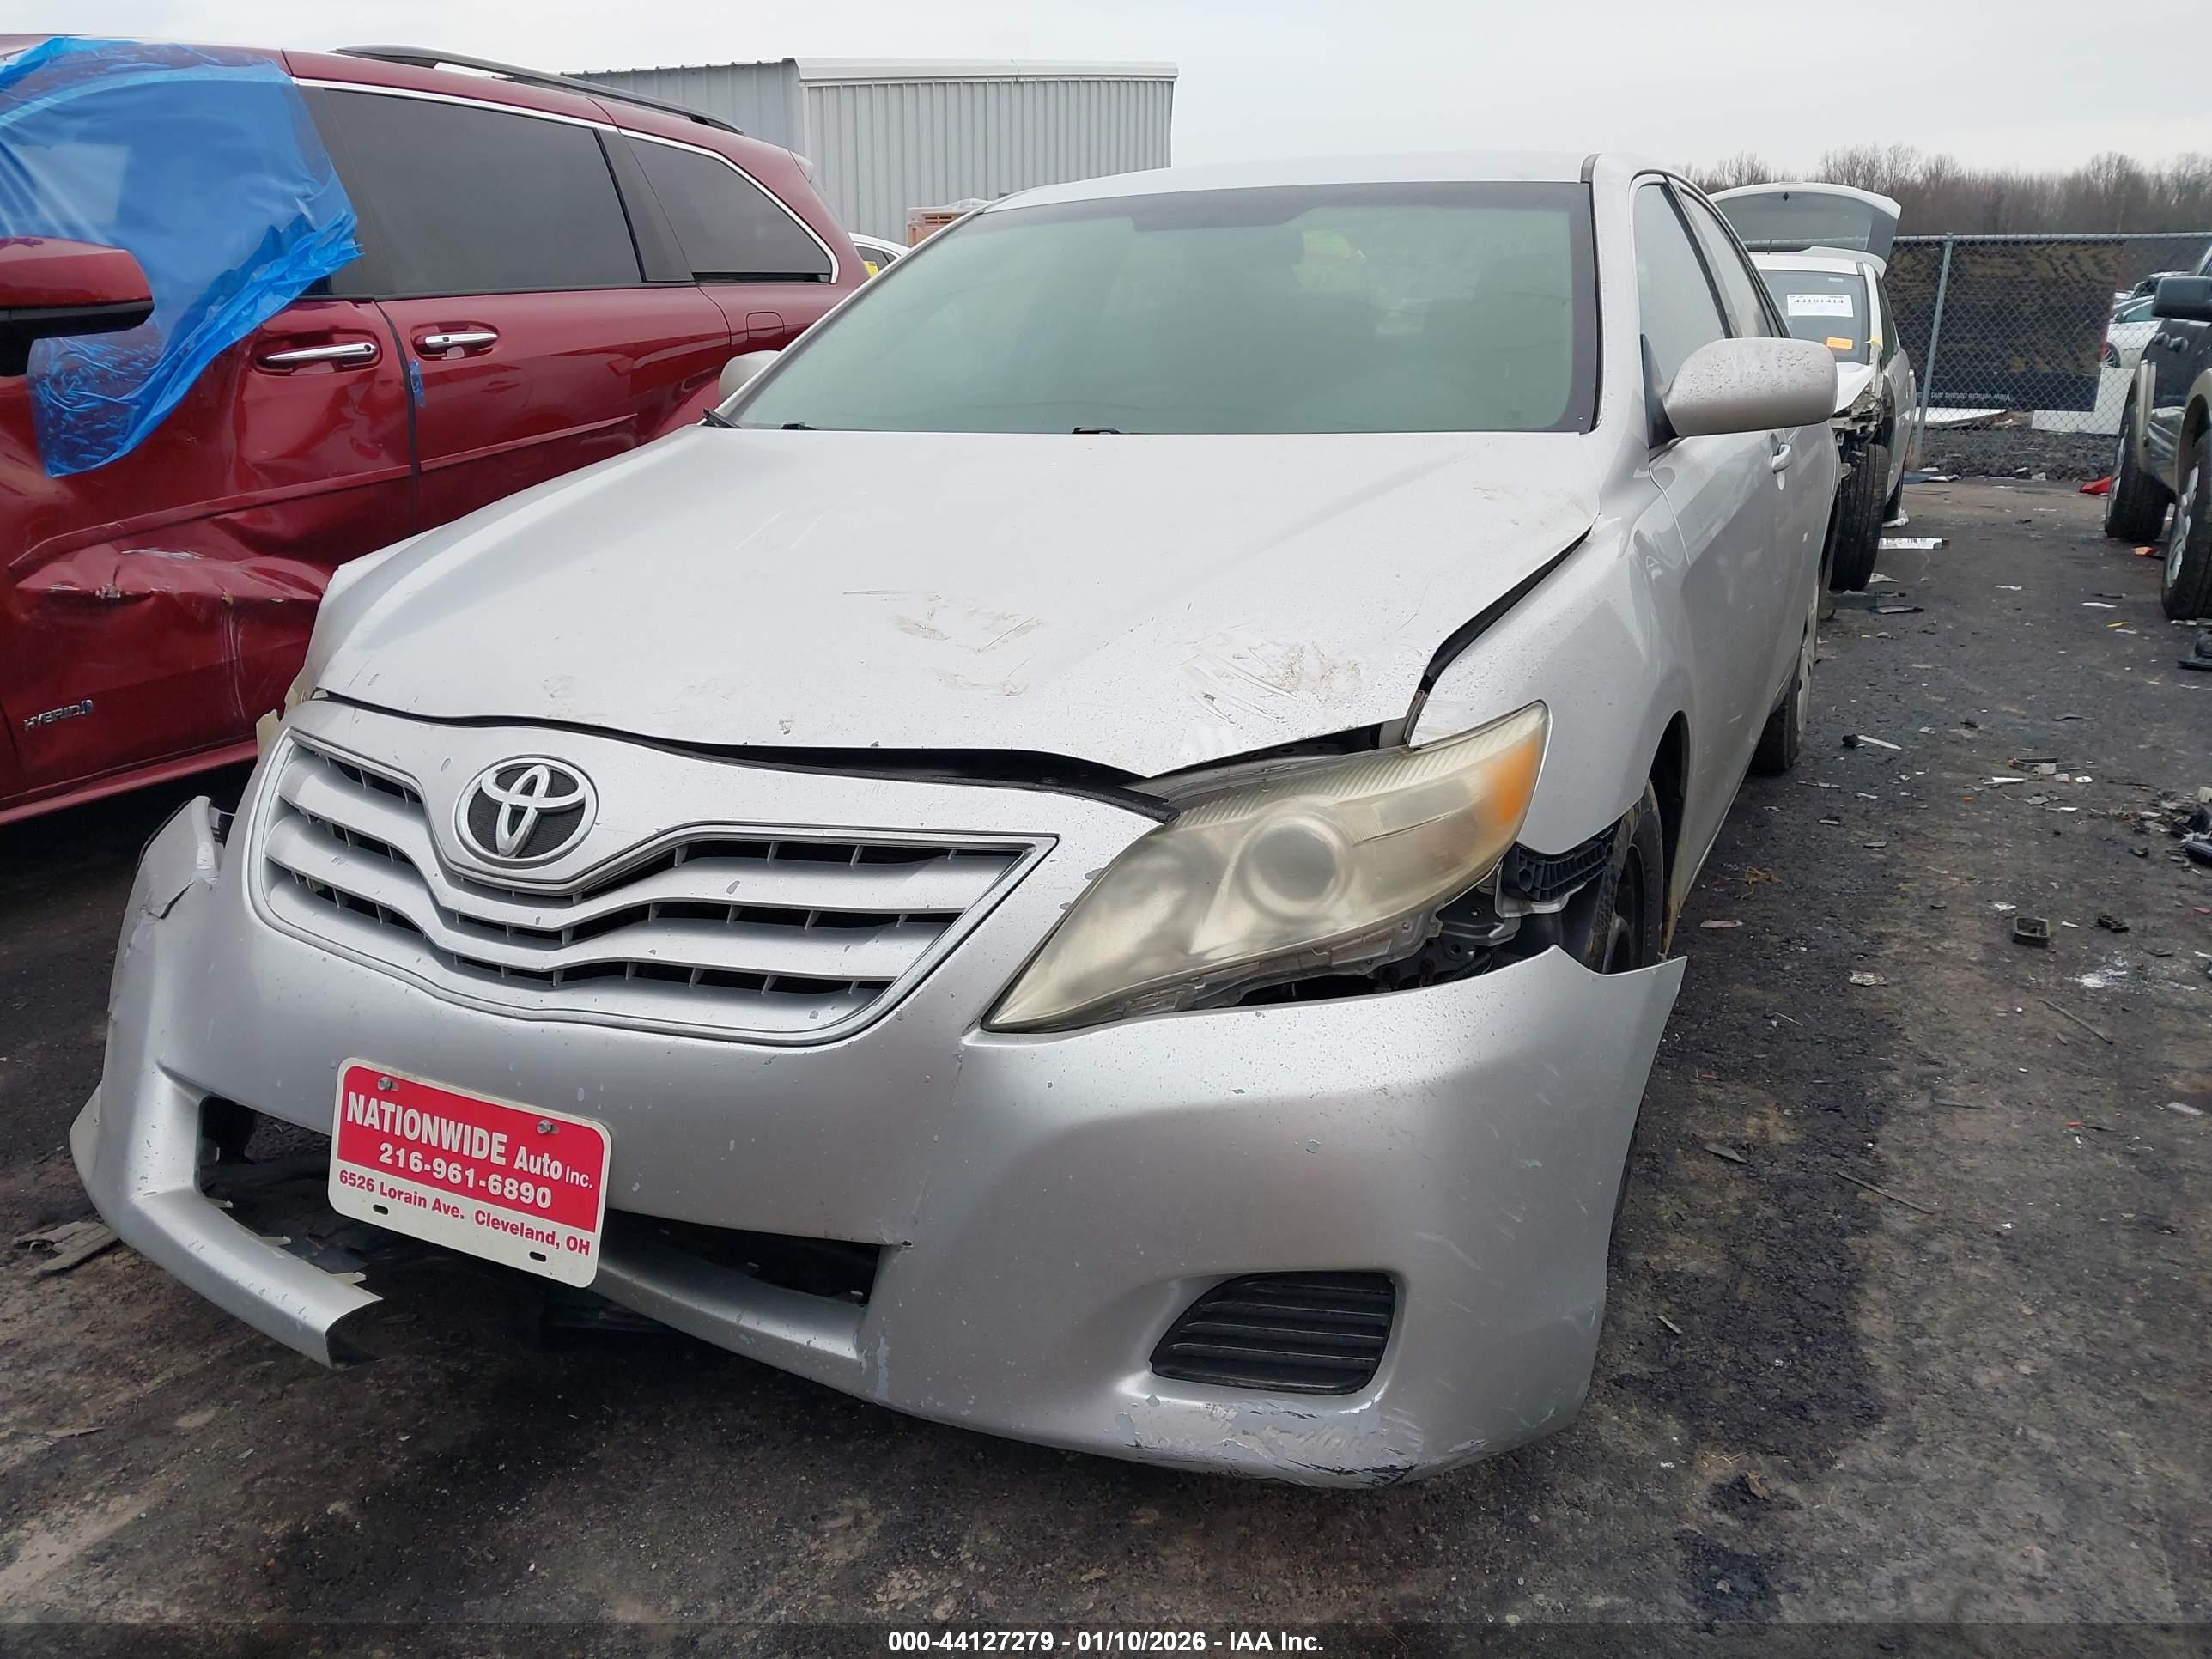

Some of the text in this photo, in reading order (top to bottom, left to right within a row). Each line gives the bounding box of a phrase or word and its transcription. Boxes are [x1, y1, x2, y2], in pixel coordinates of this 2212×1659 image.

[22, 704, 80, 731] HYBRID
[346, 1091, 594, 1188] NATIONWIDE Auto Inc.
[379, 1142, 552, 1209] 216-961-6890
[339, 1170, 591, 1256] 6526 Lorain Ave. Cleveland, OH
